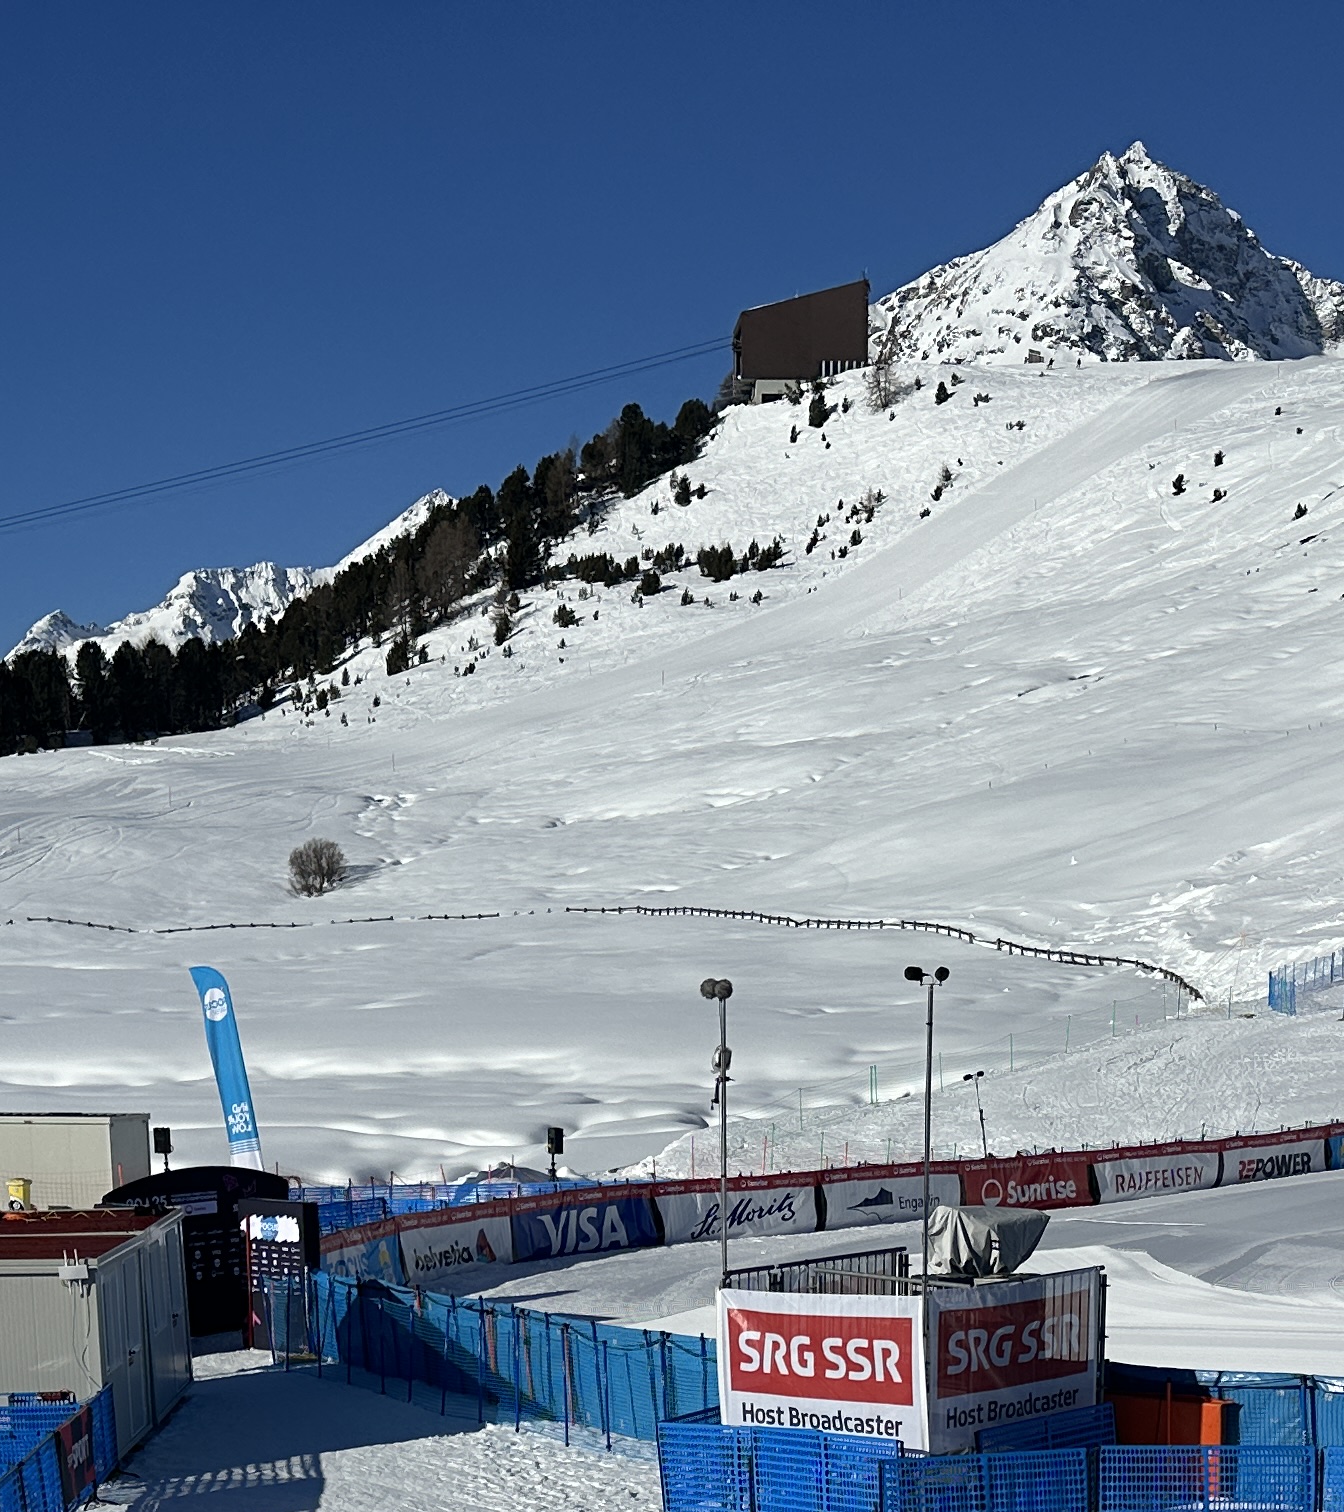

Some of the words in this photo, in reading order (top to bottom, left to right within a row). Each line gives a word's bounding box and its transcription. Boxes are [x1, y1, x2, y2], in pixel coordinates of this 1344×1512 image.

[1006, 1175, 1077, 1204] Sunrise
[1115, 1166, 1204, 1194] RAIFFEISEN
[716, 1193, 796, 1234] Moritz
[898, 1194, 940, 1212] Engain
[536, 1204, 629, 1256] VISA
[414, 1240, 475, 1272] helvetia
[738, 1331, 816, 1378] SRG
[821, 1337, 903, 1384] SSR
[946, 1325, 1016, 1376] SRG
[1017, 1314, 1081, 1364] SSR
[742, 1402, 785, 1427] Host
[788, 1406, 903, 1438] Broadcaster
[946, 1404, 984, 1430] Host
[987, 1388, 1080, 1422] Broadcaster
